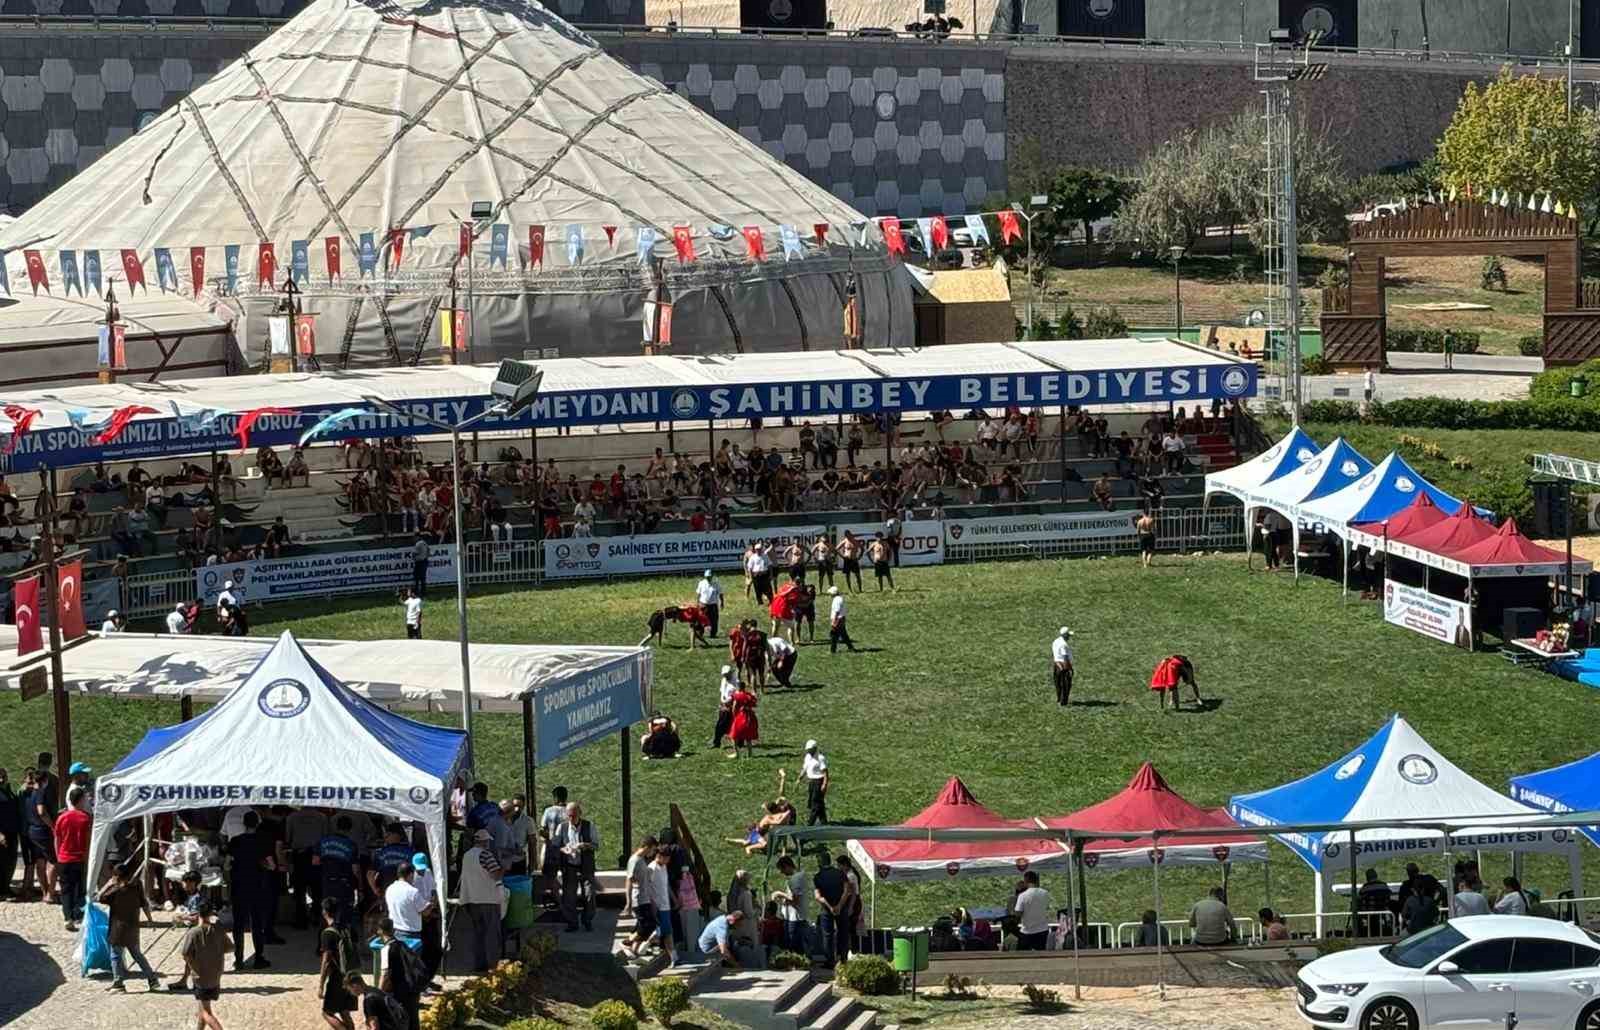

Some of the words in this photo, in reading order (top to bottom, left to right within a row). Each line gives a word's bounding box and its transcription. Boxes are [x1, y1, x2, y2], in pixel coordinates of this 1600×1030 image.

[531, 391, 659, 420] MEYDANI
[665, 541, 679, 553] ER
[682, 538, 746, 553] MEYDANINA
